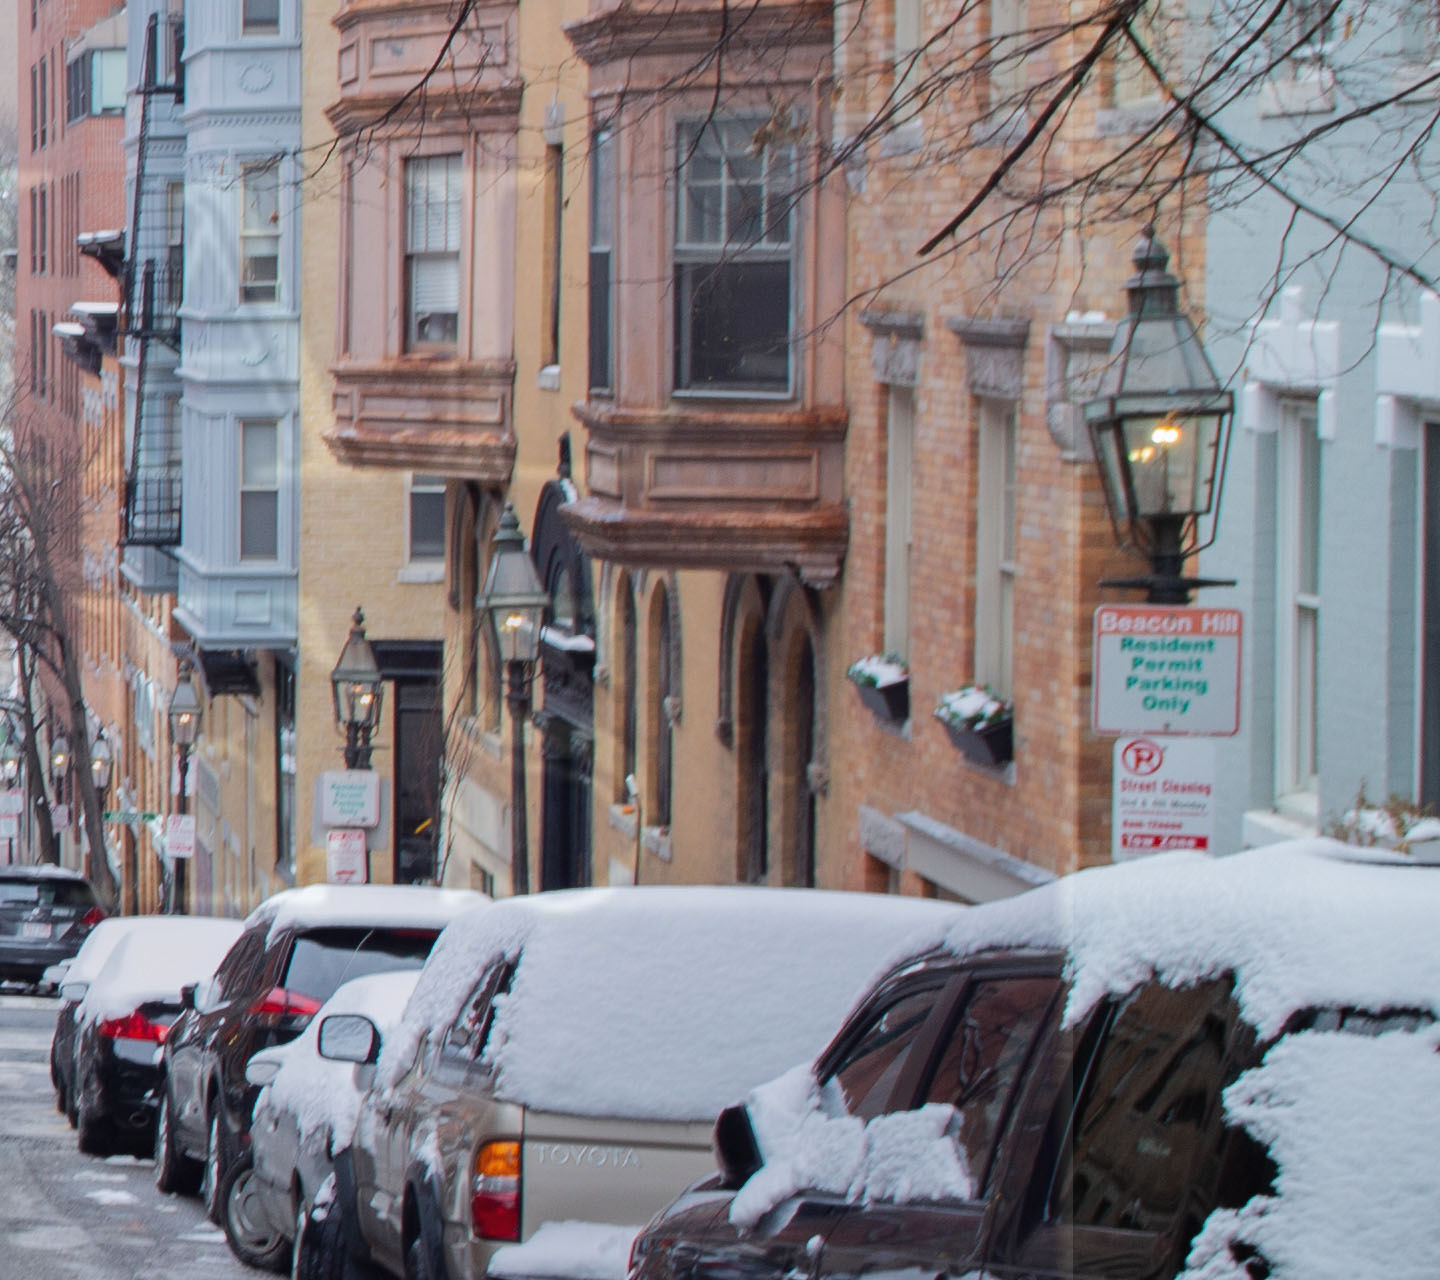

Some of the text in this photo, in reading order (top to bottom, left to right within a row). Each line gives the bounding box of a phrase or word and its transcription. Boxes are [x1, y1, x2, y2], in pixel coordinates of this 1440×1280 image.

[1100, 612, 1239, 634] Beacon Hill
[1120, 638, 1216, 652] Resident
[1131, 657, 1203, 671] Permit
[1126, 676, 1208, 695] Parking
[1142, 696, 1190, 714] Only
[1120, 780, 1211, 795] Street Cleaning
[532, 1144, 641, 1168] TOYOTA
